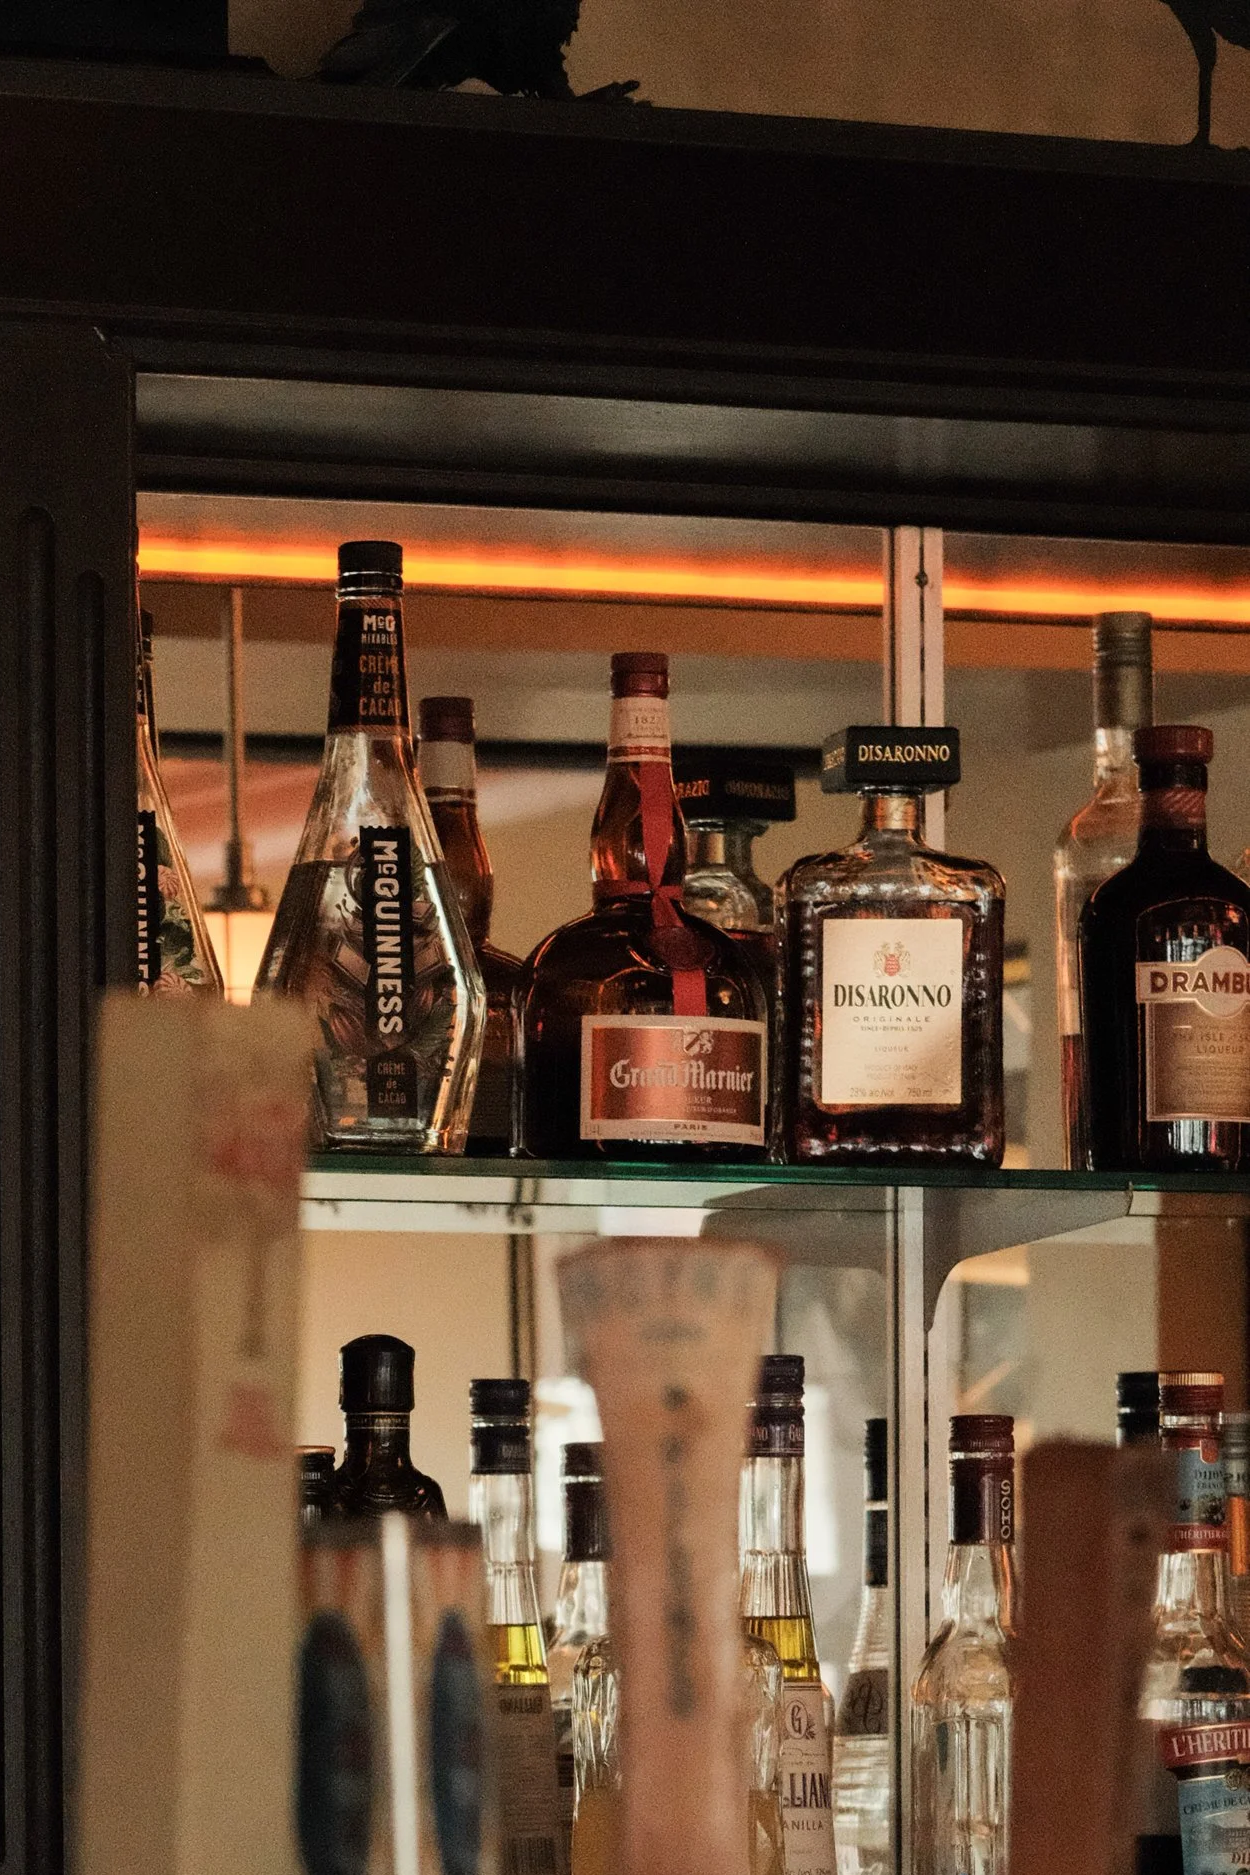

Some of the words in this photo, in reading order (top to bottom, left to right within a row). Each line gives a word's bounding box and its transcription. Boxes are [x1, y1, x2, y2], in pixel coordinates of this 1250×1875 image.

[362, 614, 396, 632] McG
[373, 676, 390, 695] de
[857, 745, 951, 763] DISARONNO
[373, 839, 403, 1035] McGUINNESS
[833, 984, 952, 1010] DISARONNO
[609, 1058, 679, 1089] Grand
[681, 1059, 754, 1093] Marnier
[1000, 1480, 1011, 1539] SOHO
[1224, 1799, 1237, 1808] DE
